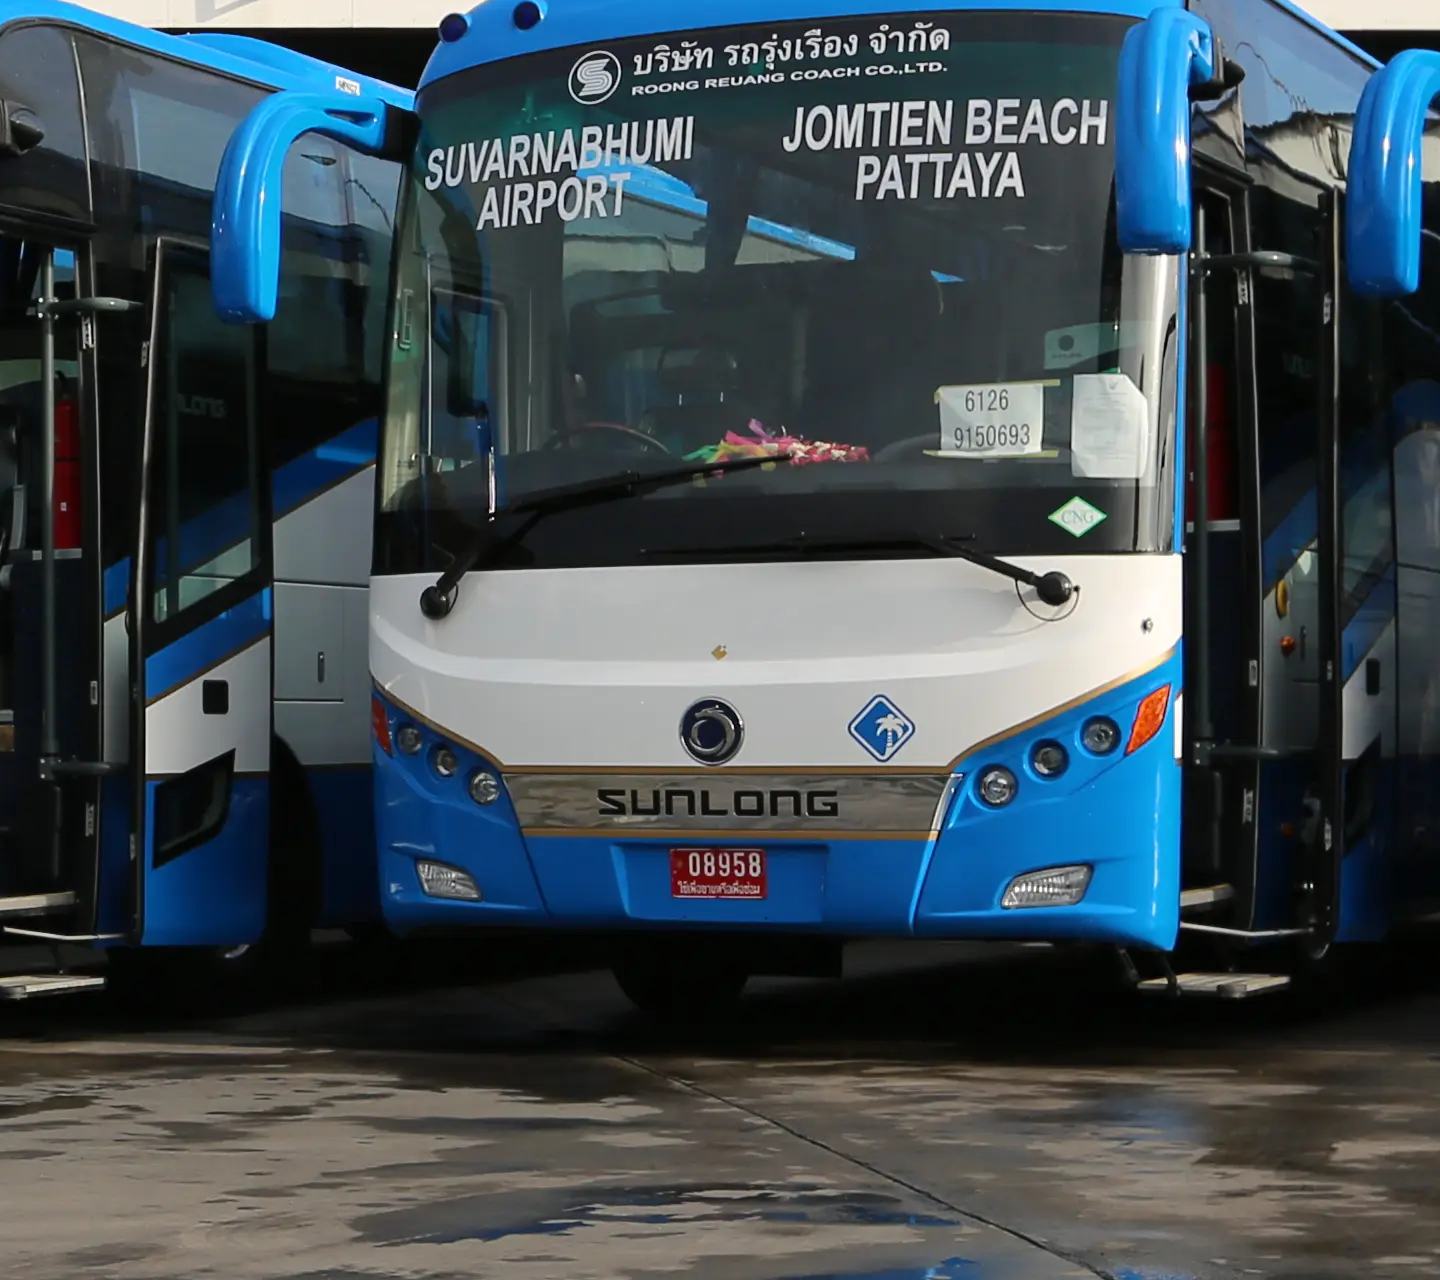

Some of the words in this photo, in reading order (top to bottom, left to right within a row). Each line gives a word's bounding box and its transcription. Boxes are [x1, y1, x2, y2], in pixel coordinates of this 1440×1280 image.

[633, 40, 714, 76] บริษัท
[723, 28, 859, 71] รถรุ่งเรือง
[869, 21, 951, 55] จำกัด
[631, 80, 700, 97] ROONG
[704, 72, 785, 90] REUANG
[790, 65, 861, 82] COACH
[865, 61, 949, 76] CO.,LTD.
[782, 99, 954, 153] JOMTIEN
[965, 98, 1109, 146] BEACH
[424, 115, 695, 192] SUVARNABHUMI
[855, 151, 1025, 201] PATTAYA
[476, 172, 632, 231] AIRPORT
[964, 389, 1010, 412] 6126
[954, 423, 1031, 450] 9150693
[1060, 510, 1095, 525] CNG
[597, 789, 839, 817] SUNLONG
[688, 852, 762, 878] 08958
